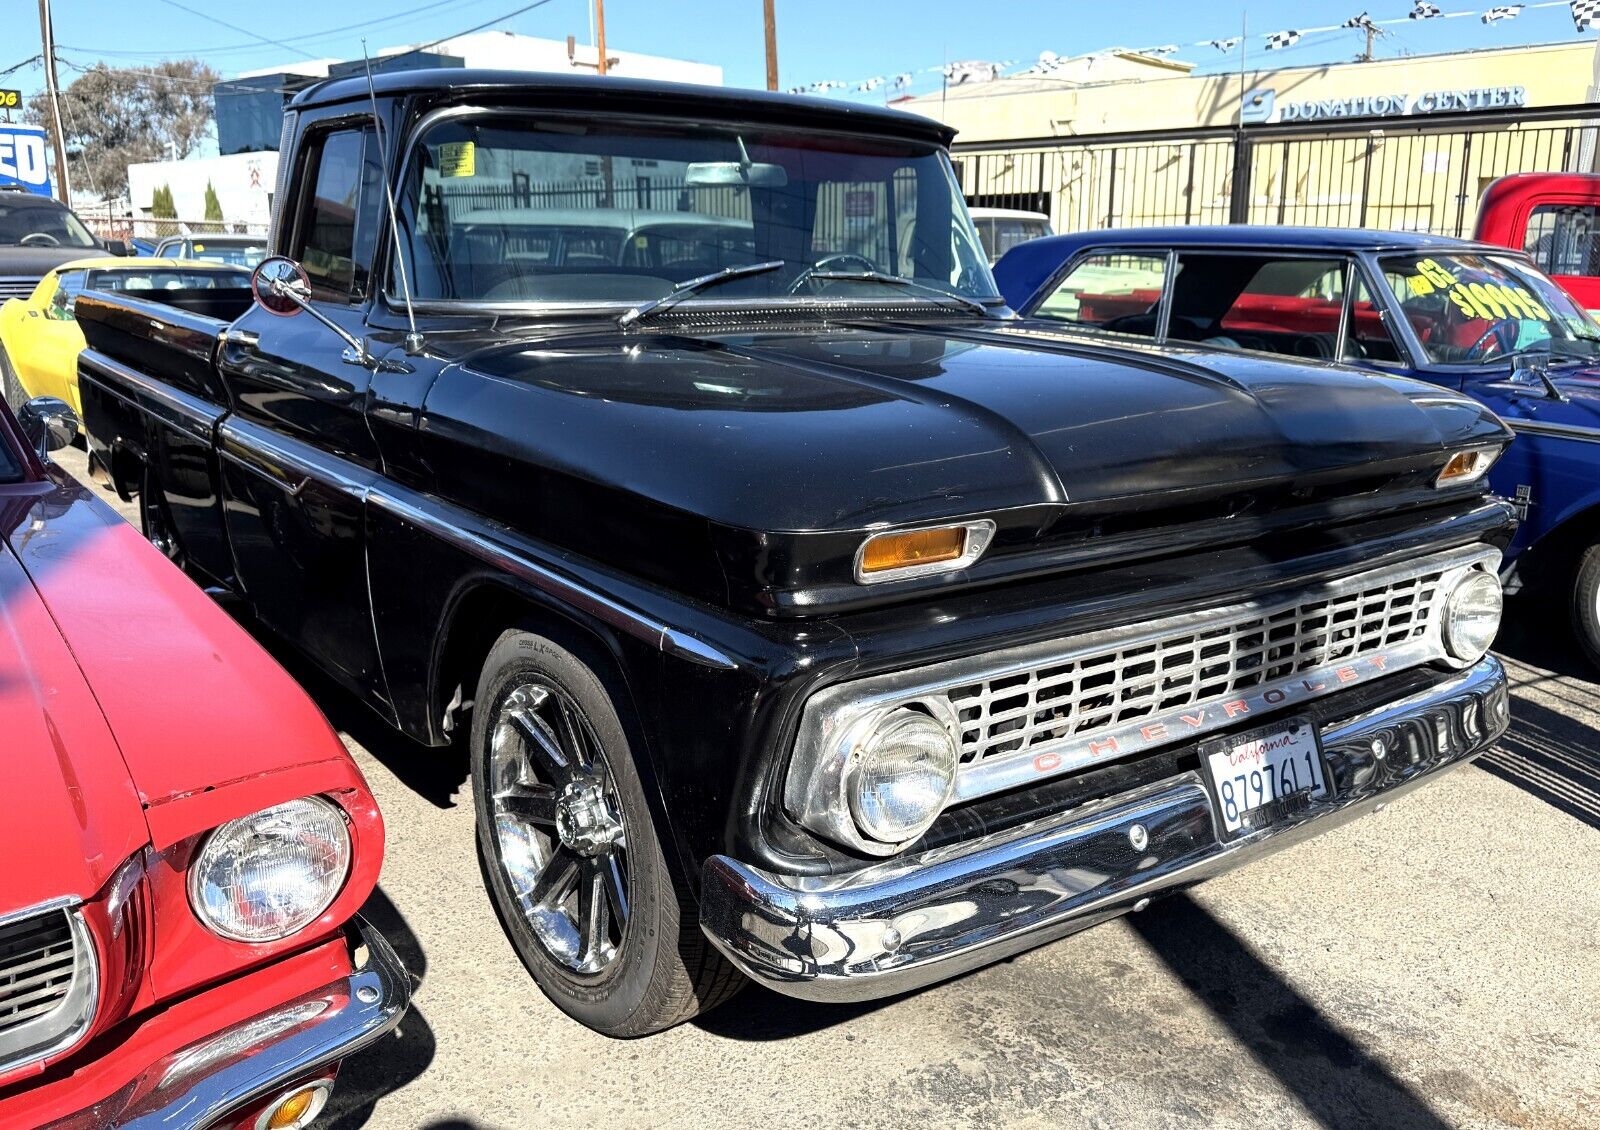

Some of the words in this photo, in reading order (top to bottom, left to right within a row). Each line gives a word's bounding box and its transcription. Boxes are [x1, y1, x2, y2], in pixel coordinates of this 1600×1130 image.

[1280, 94, 1408, 121] DONATION
[1417, 86, 1525, 112] CENTER
[1416, 258, 1457, 289] 63
[1449, 282, 1550, 322] $19995
[533, 641, 546, 655] LX
[1032, 655, 1389, 772] CHEVROLET
[1229, 735, 1299, 766] California
